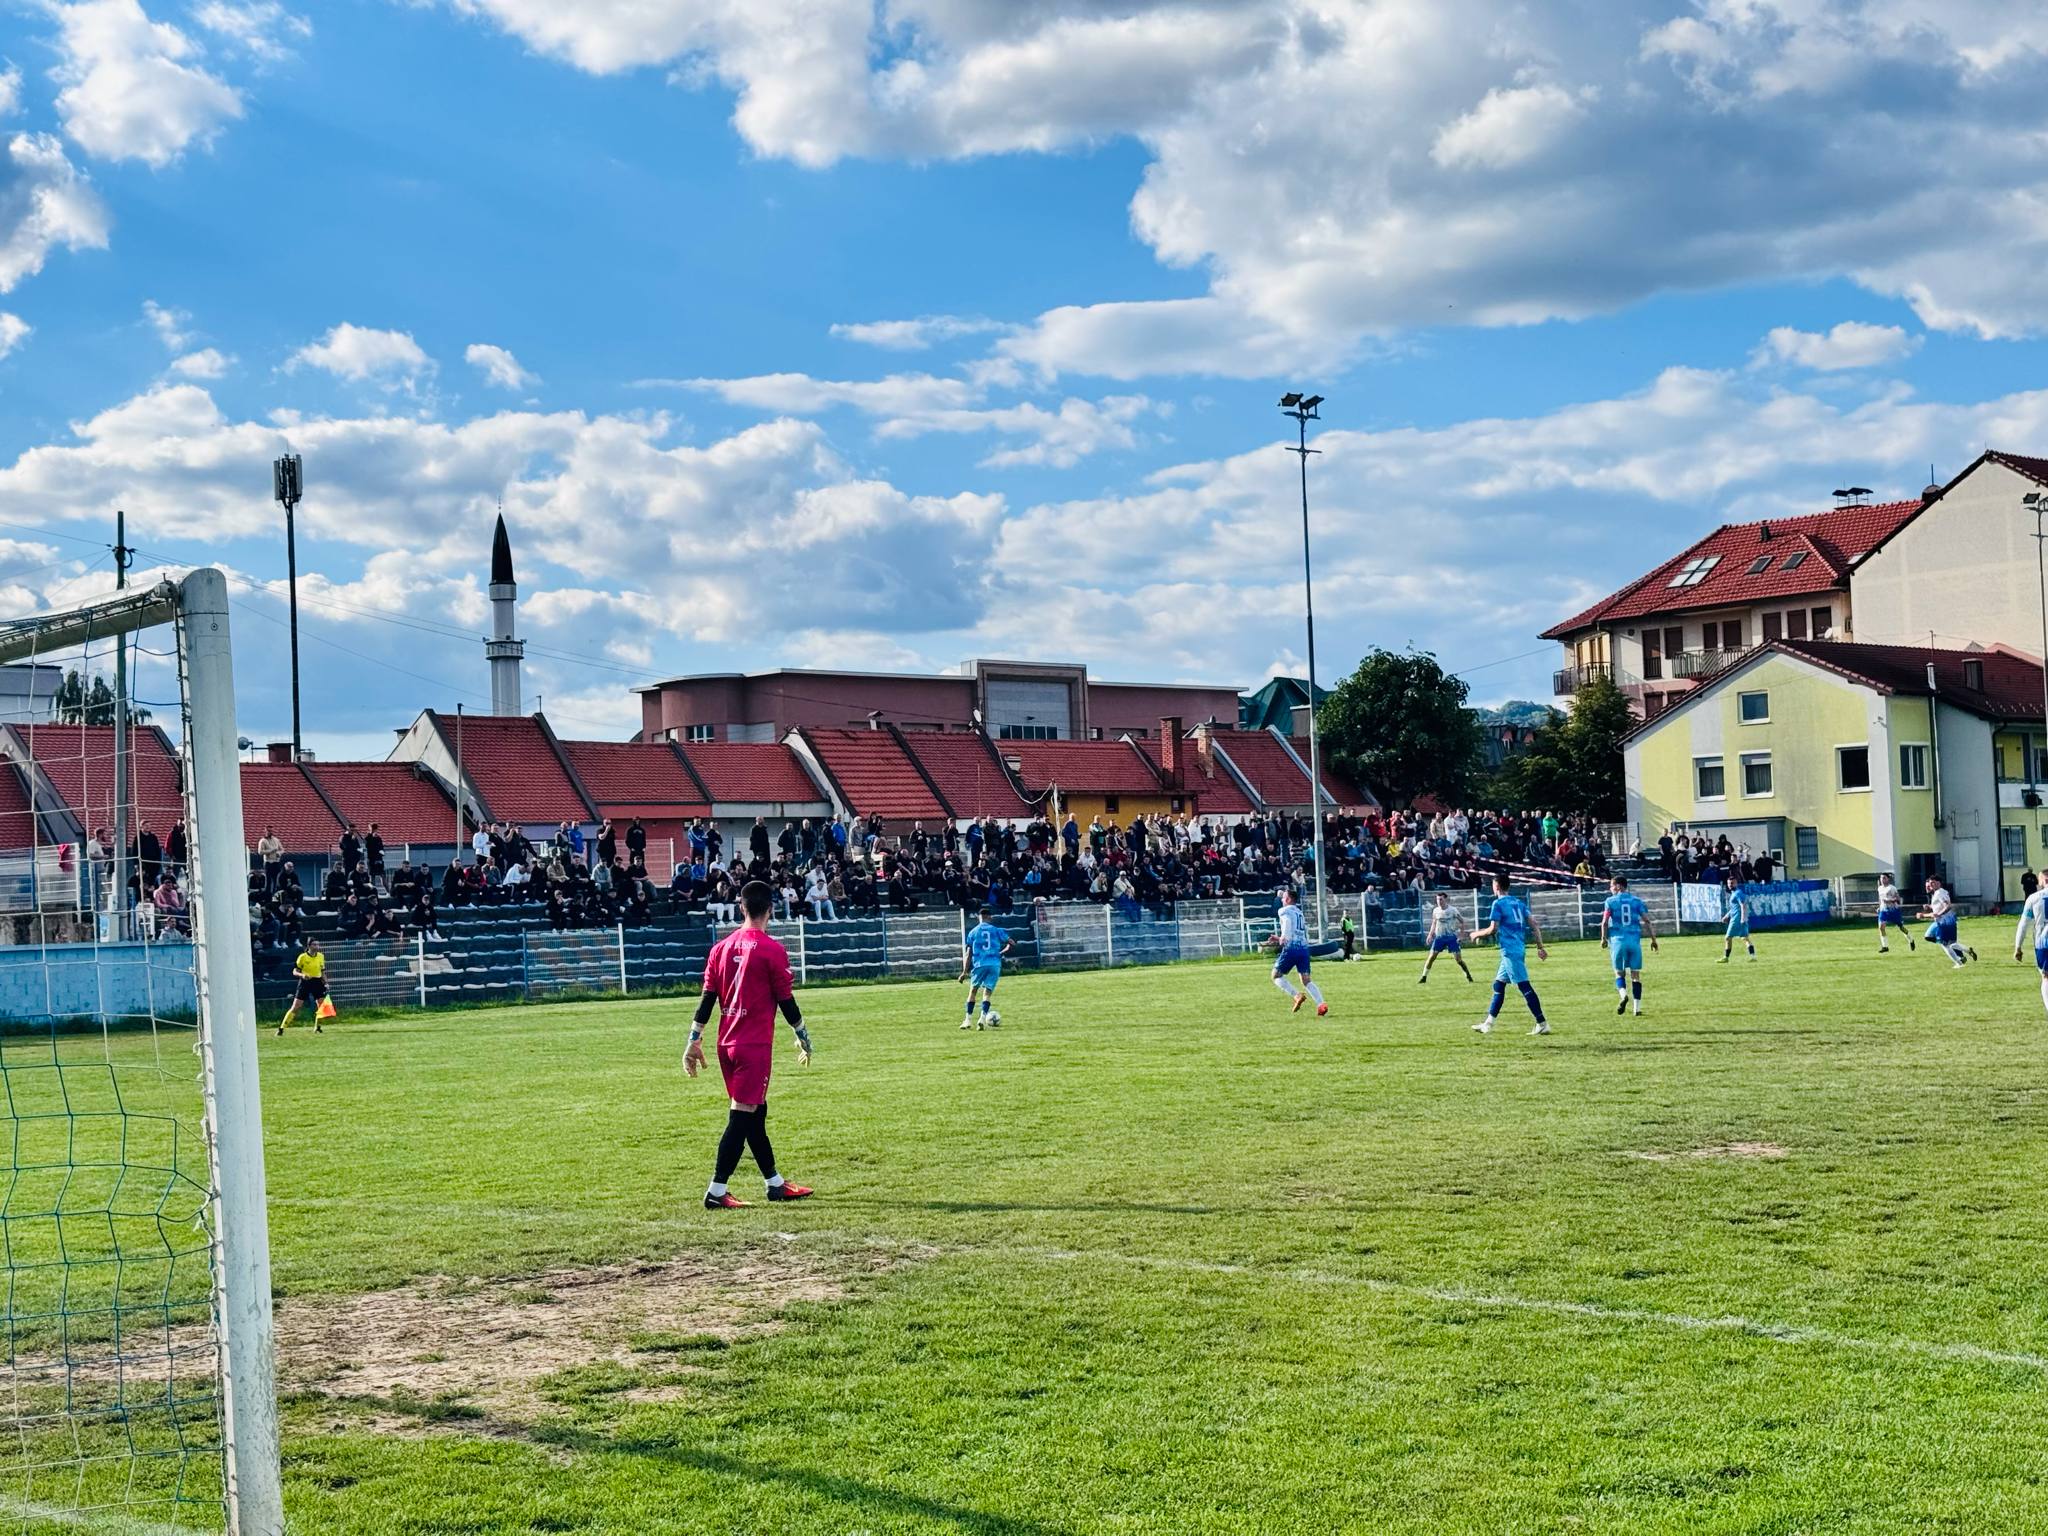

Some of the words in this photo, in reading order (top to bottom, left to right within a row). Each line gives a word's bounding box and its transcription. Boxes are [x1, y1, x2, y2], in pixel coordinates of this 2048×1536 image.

[1294, 912, 1306, 931] 10
[1621, 903, 1632, 926] 8
[981, 930, 991, 951] 3
